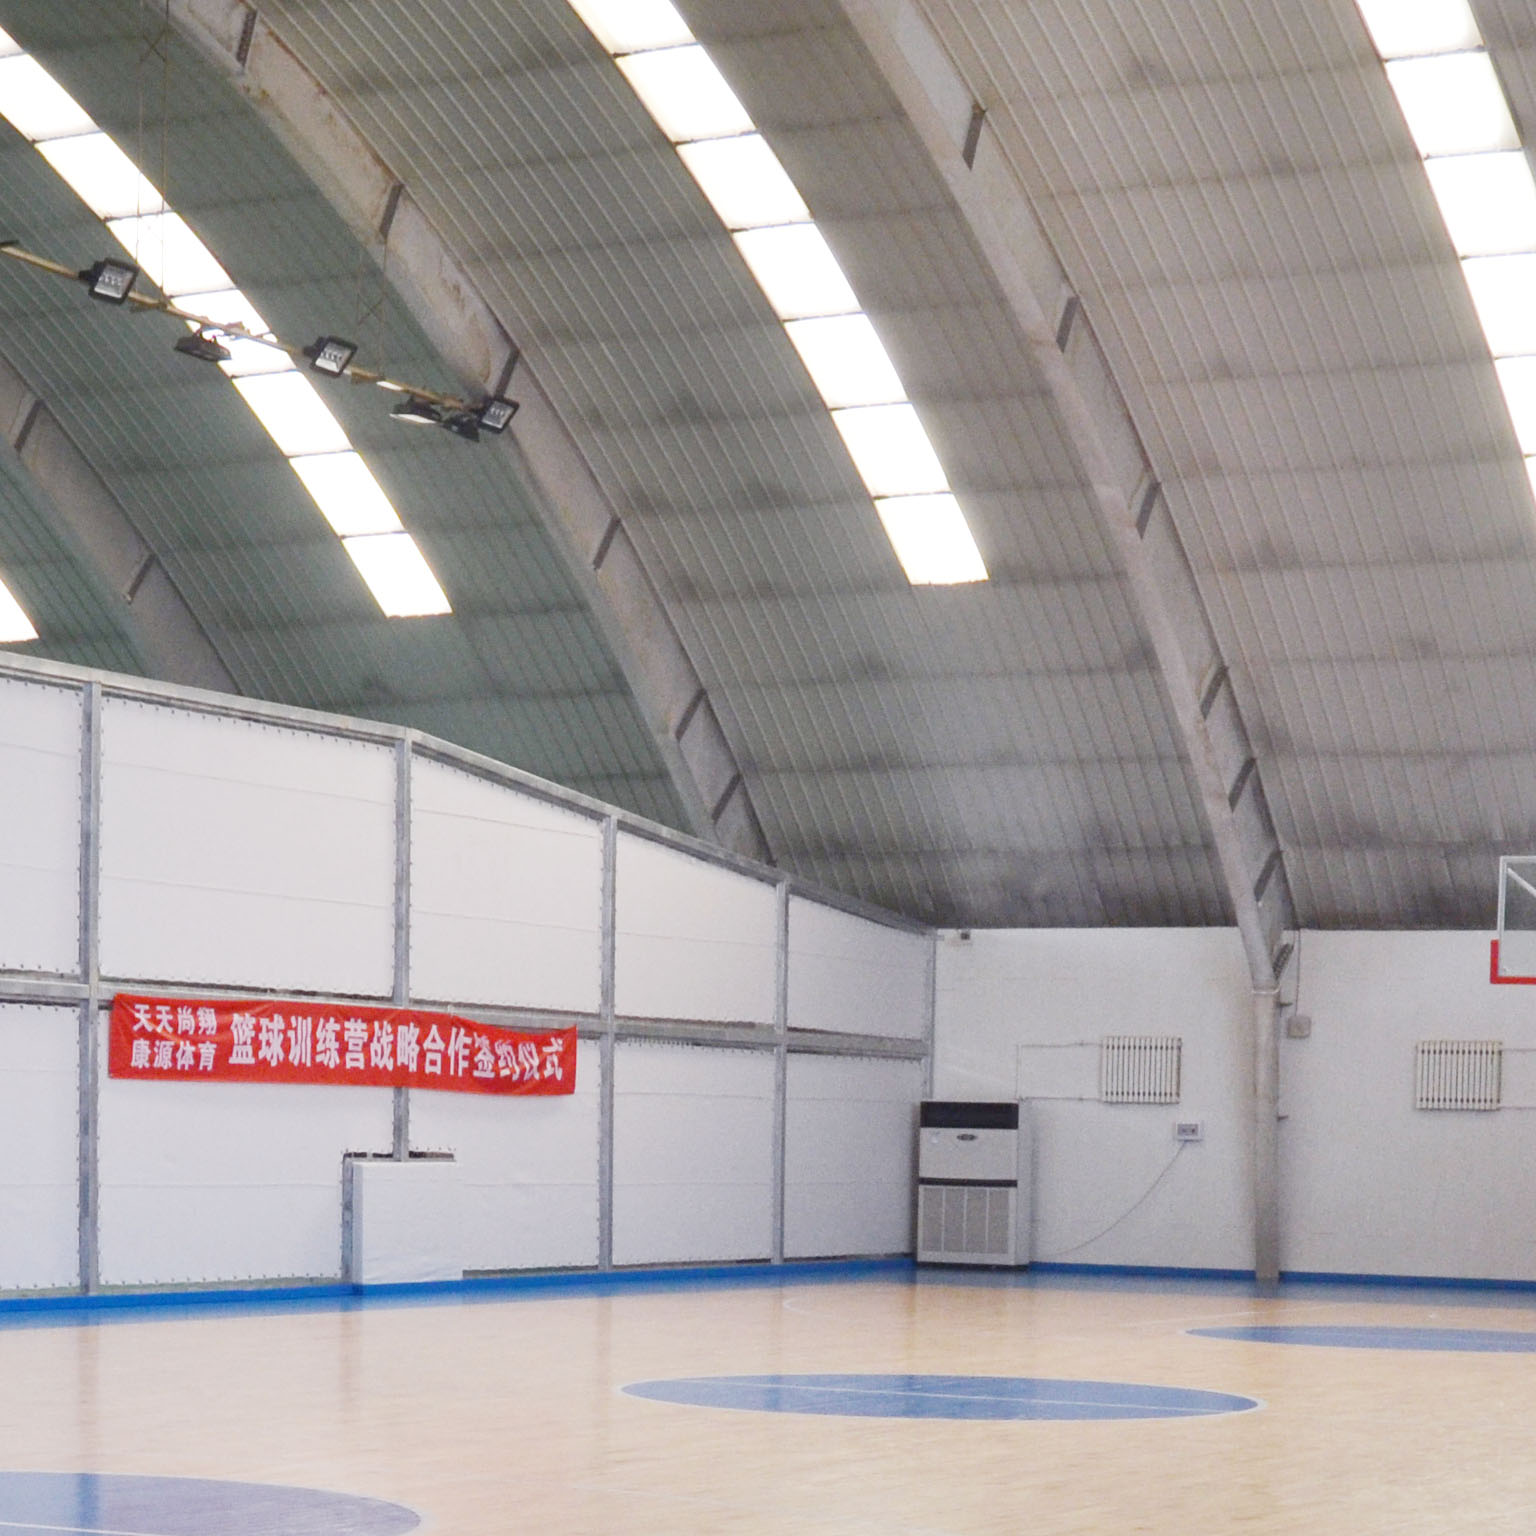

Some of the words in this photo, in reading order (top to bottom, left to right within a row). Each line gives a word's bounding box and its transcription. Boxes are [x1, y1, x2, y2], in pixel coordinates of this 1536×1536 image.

[132, 1003, 217, 1035] 天天尚翔
[130, 1038, 217, 1071] 康源体育
